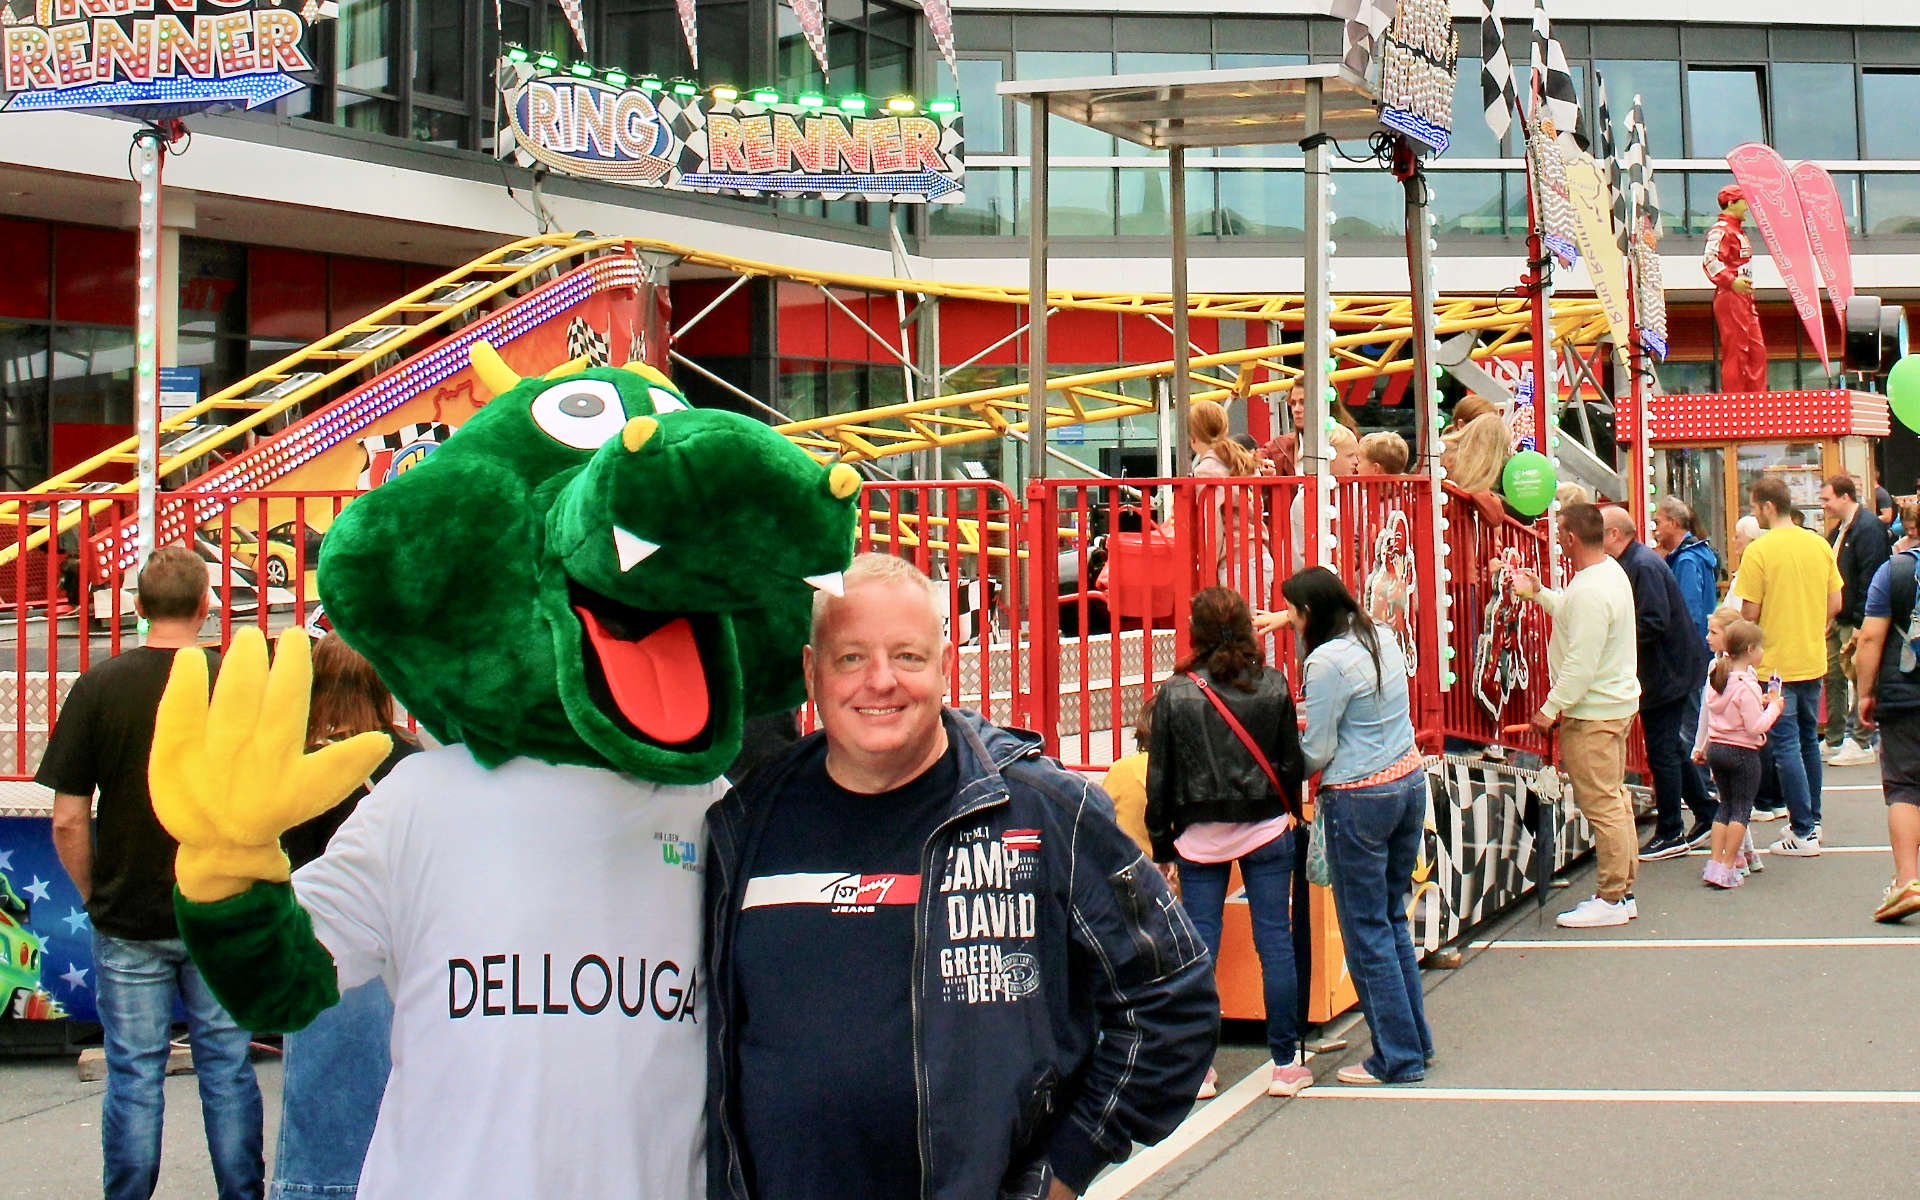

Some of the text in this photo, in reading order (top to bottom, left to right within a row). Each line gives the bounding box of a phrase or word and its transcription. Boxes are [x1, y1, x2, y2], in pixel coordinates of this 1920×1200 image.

[4, 10, 312, 90] RENNER
[527, 82, 661, 158] RING
[707, 113, 949, 174] RENNER
[820, 874, 896, 904] Tommy
[940, 841, 1020, 893] CAMP
[831, 904, 876, 914] JEANS
[947, 893, 1036, 941] DAVID
[940, 944, 1003, 978] GREEN
[448, 953, 698, 1025] DELLOUGA
[966, 973, 1018, 1005] DEPT.
